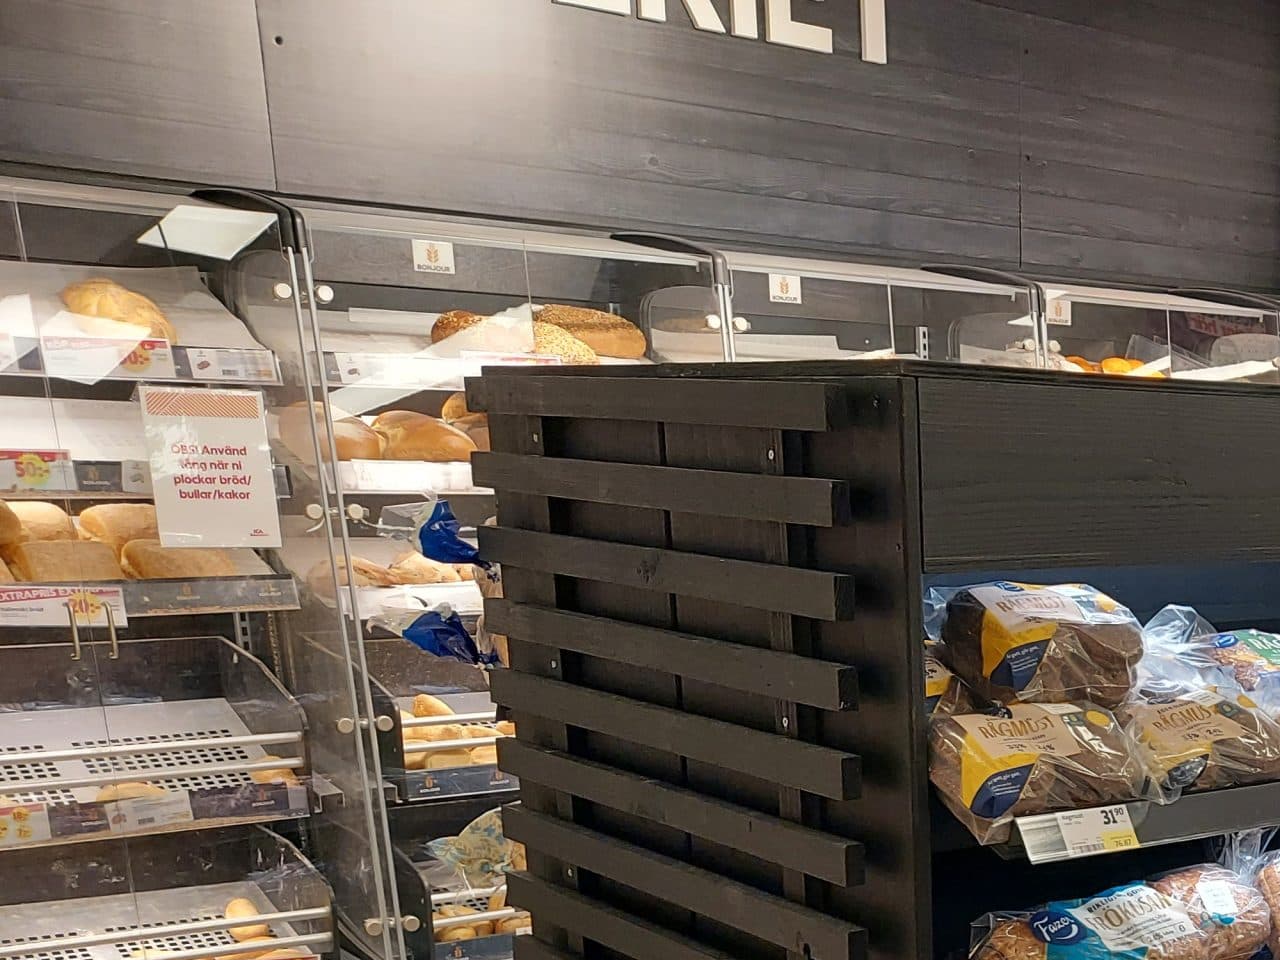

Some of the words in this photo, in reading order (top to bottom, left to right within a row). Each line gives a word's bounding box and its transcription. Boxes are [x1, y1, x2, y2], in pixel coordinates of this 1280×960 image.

[201, 445, 248, 456] Använd
[209, 460, 229, 471] när
[231, 460, 242, 470] ni
[173, 474, 217, 486] plockar
[219, 473, 252, 485] bröd/
[179, 489, 251, 500] bullar/kakor
[0, 588, 54, 601] XTRAPRIS
[978, 714, 1055, 740] RÅGMÜST
[1033, 916, 1076, 942] Fazer
